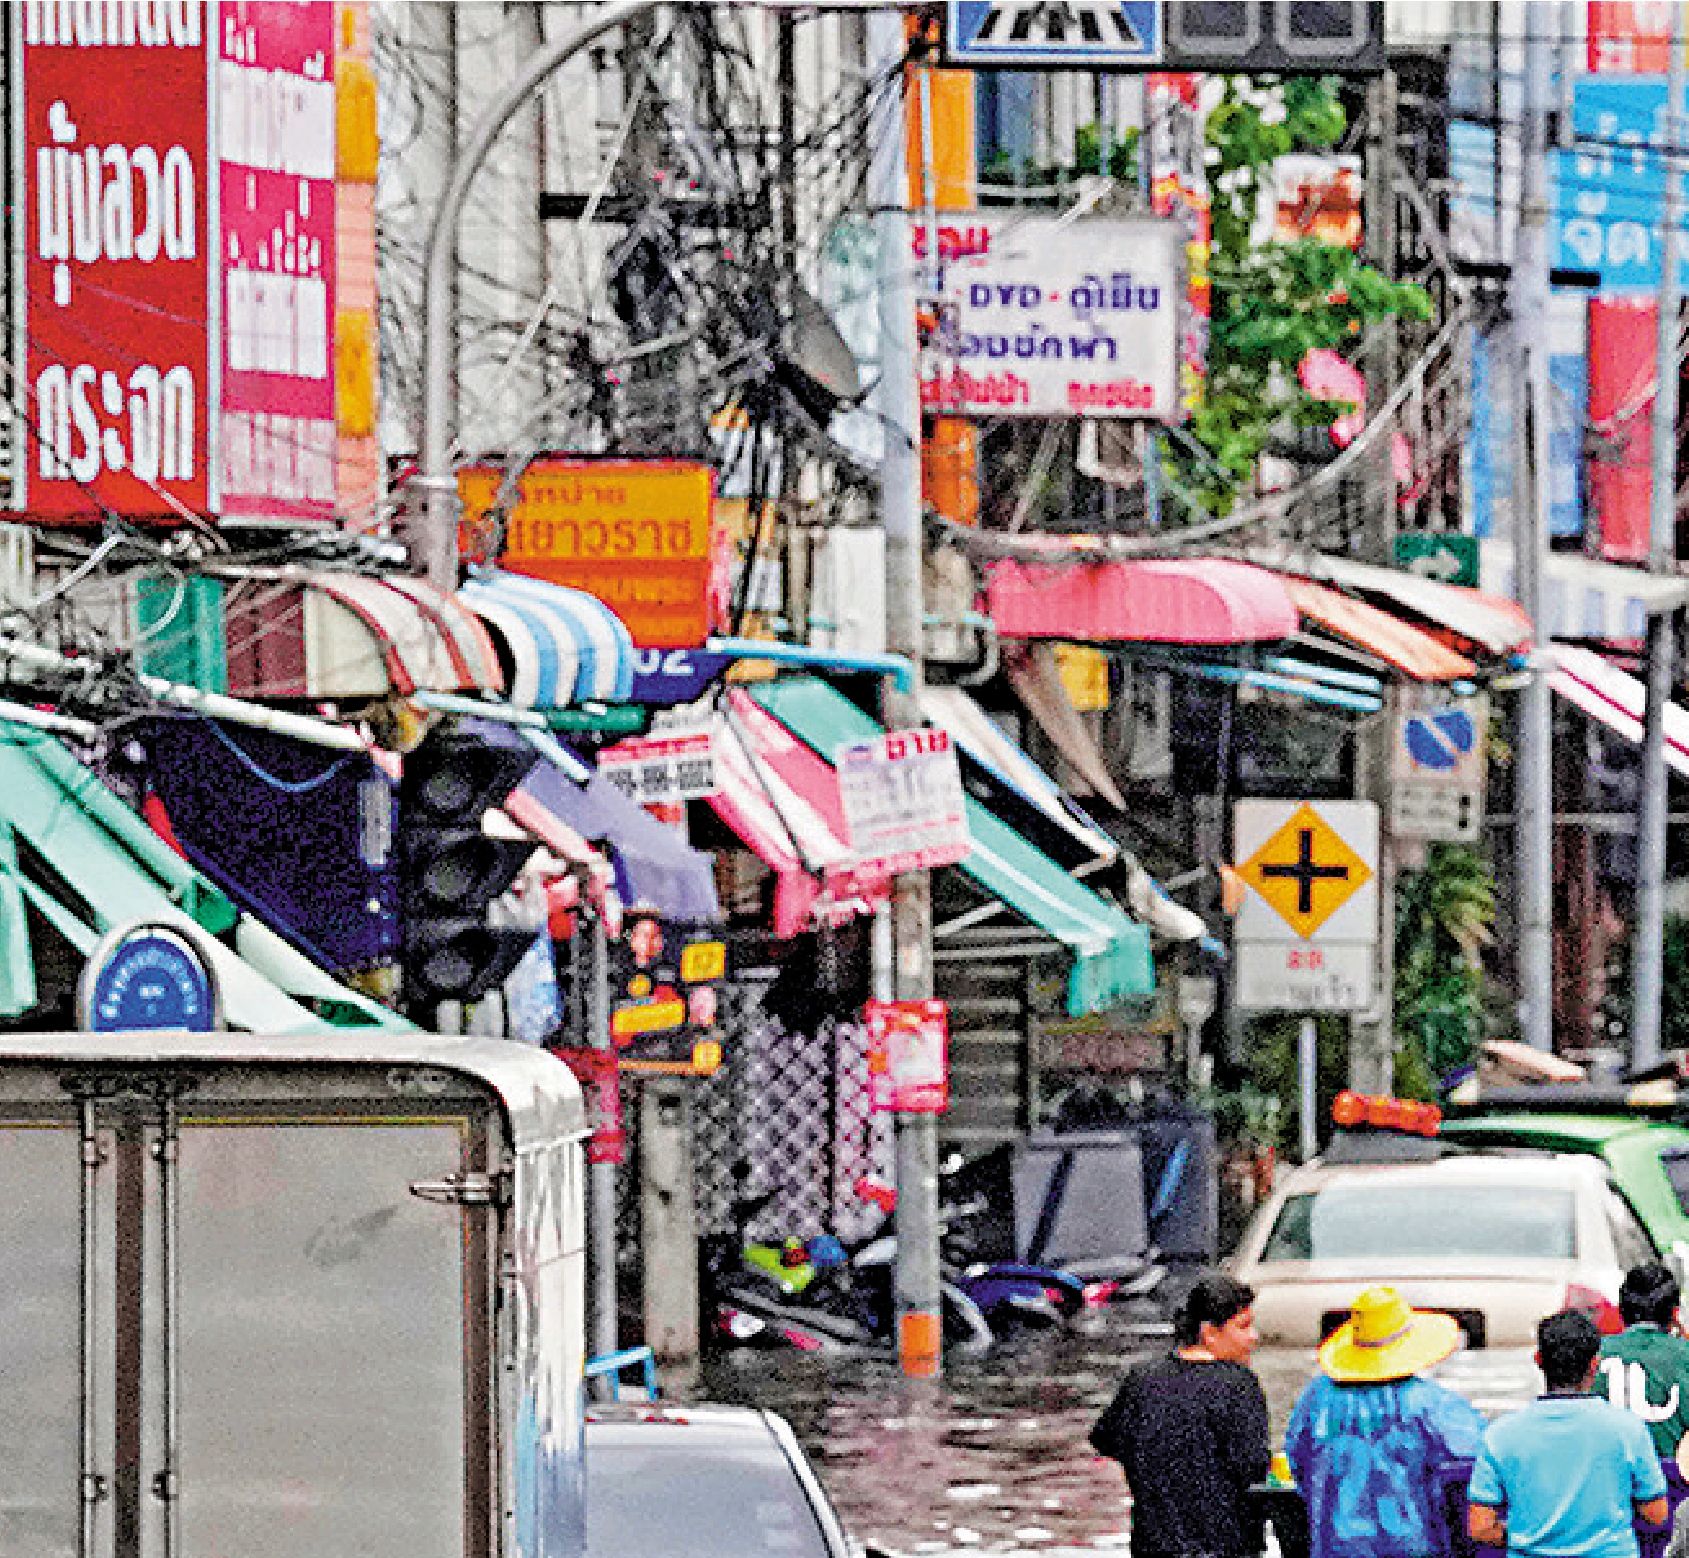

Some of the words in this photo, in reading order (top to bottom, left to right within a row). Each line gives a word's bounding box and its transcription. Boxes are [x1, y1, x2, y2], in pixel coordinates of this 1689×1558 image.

[37, 100, 197, 307] มุ้งลวด
[970, 283, 1041, 308] DVD
[37, 363, 197, 483] กระจก
